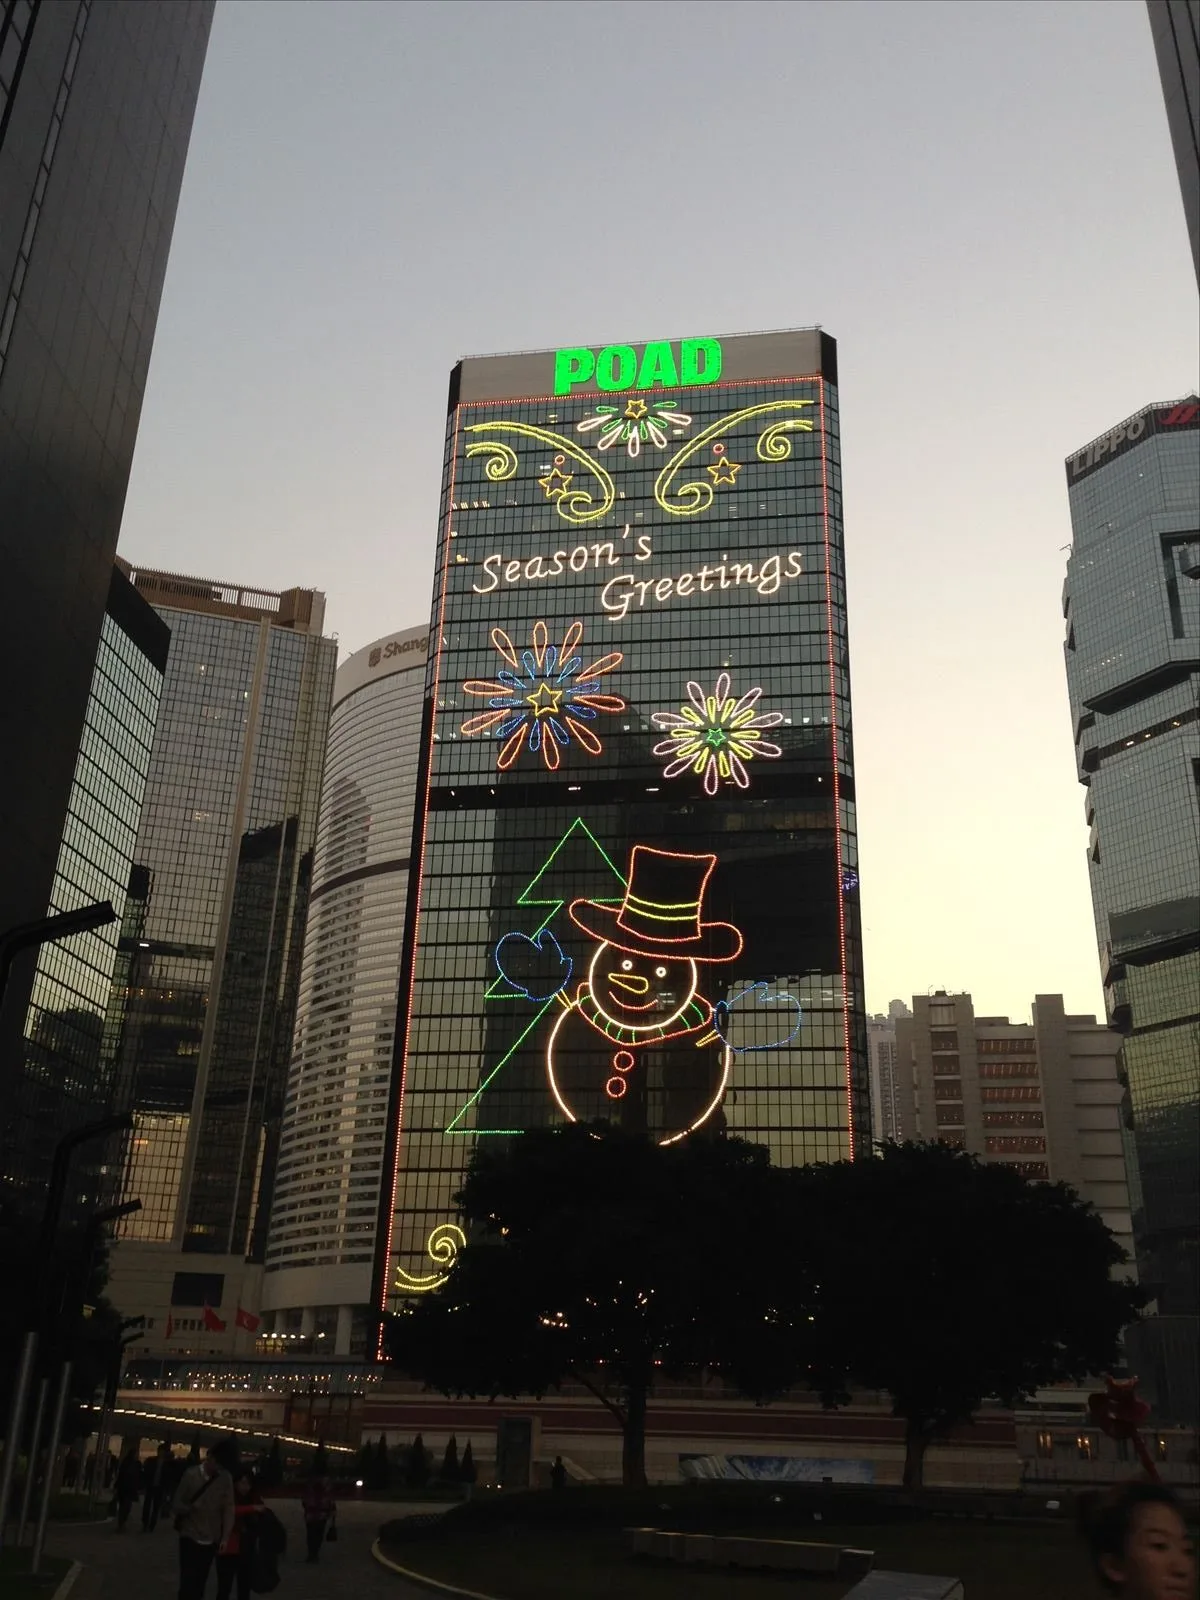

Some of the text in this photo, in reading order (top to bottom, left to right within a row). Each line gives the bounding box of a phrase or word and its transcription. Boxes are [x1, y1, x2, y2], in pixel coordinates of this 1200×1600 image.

[554, 337, 722, 396] POAD
[1072, 418, 1145, 476] LIPPO
[473, 524, 652, 593] Season's
[601, 550, 804, 621] Greetings
[383, 637, 429, 659] Shang
